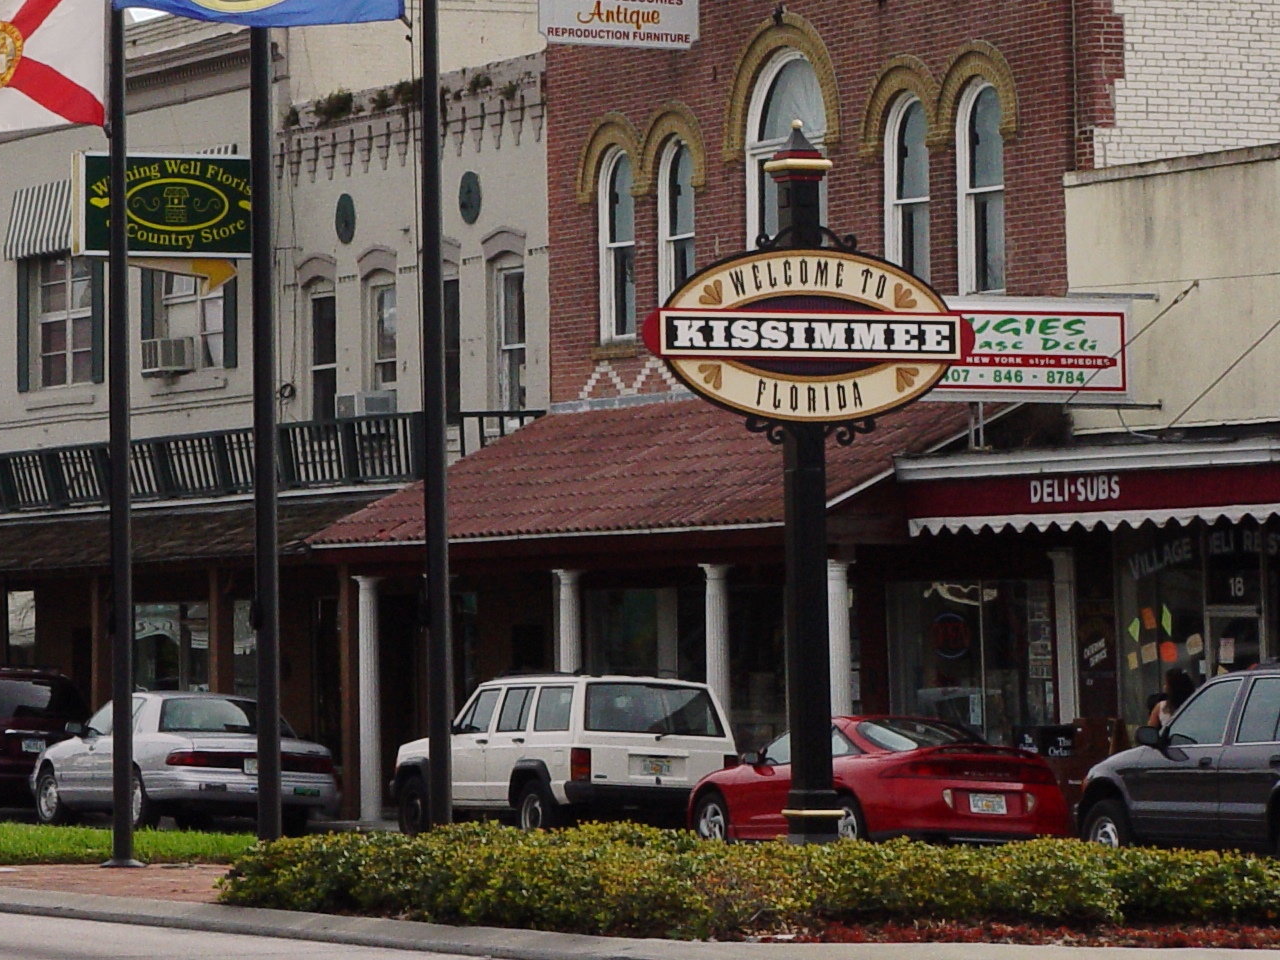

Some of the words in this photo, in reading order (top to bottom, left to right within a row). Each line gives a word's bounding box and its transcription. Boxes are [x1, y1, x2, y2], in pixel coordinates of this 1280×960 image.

[576, 1, 661, 30] Antique
[547, 26, 630, 41] REPRODUCTION
[632, 32, 691, 44] FURNITURE
[164, 159, 200, 176] Well
[206, 164, 252, 196] Floris
[126, 222, 195, 250] Country
[200, 218, 246, 243] Store
[729, 257, 844, 298] WELCOME
[860, 268, 888, 300] TO
[672, 319, 951, 352] KISSIMMEE
[966, 356, 990, 364] NEW
[994, 356, 1023, 365] YORK
[1029, 357, 1056, 366] style
[993, 369, 1023, 383] 846
[1046, 370, 1085, 384] 8784
[756, 378, 863, 414] FLORIDA
[1128, 538, 1192, 581] VILLAGE
[1228, 576, 1245, 597] 18
